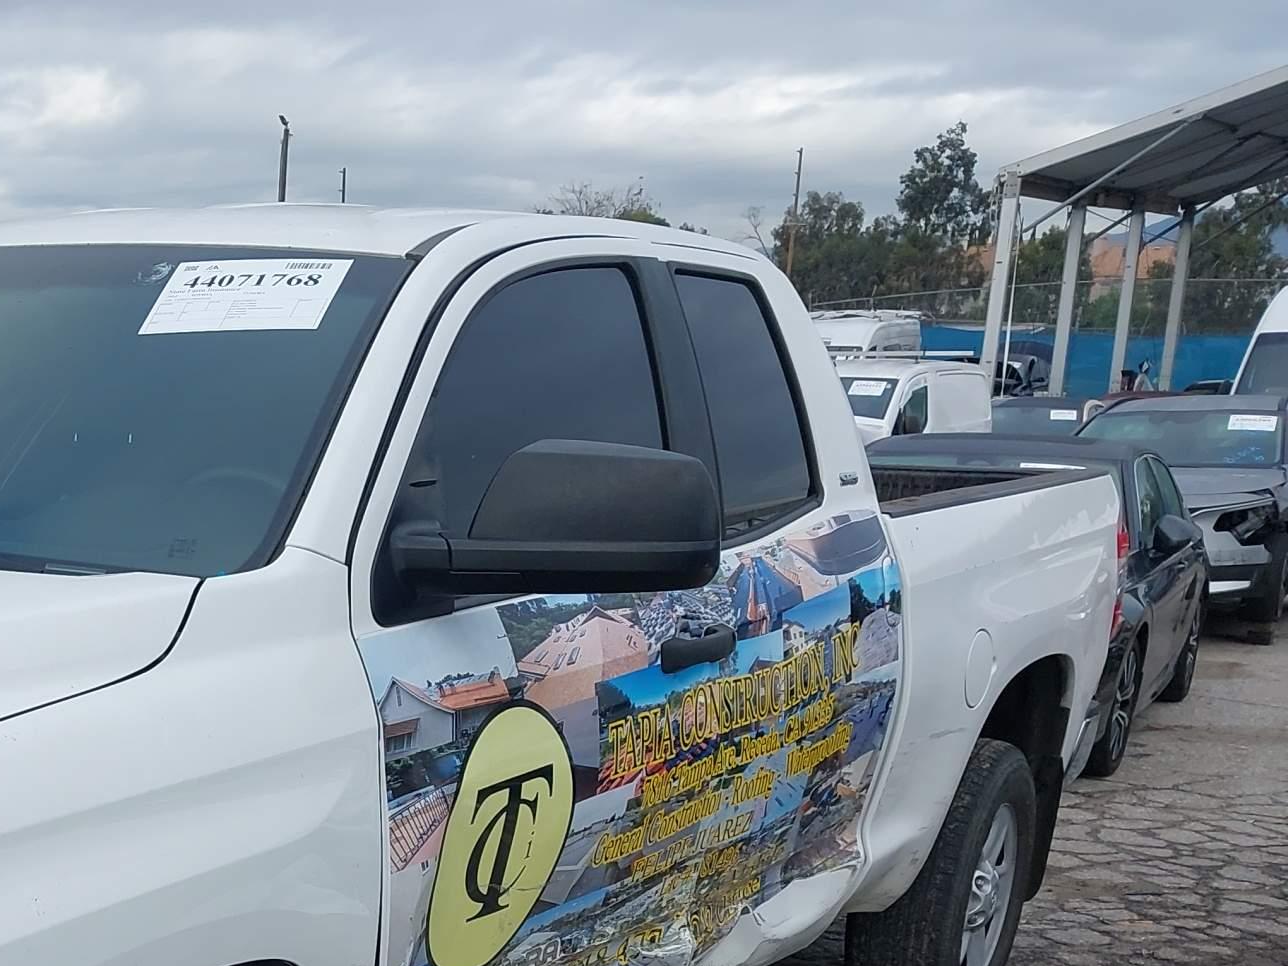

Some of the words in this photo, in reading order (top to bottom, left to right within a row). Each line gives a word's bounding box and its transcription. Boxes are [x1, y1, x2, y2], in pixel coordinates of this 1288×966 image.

[184, 272, 323, 289] 44071768
[609, 703, 676, 780] TAPIA
[831, 621, 861, 684] INC
[675, 755, 713, 792] Tampa
[783, 712, 802, 746] CA
[592, 813, 650, 867] General
[647, 787, 723, 846] Construction
[731, 766, 776, 805] Roofing
[631, 834, 694, 881] FELIPE
[692, 811, 754, 852] JUAREZ
